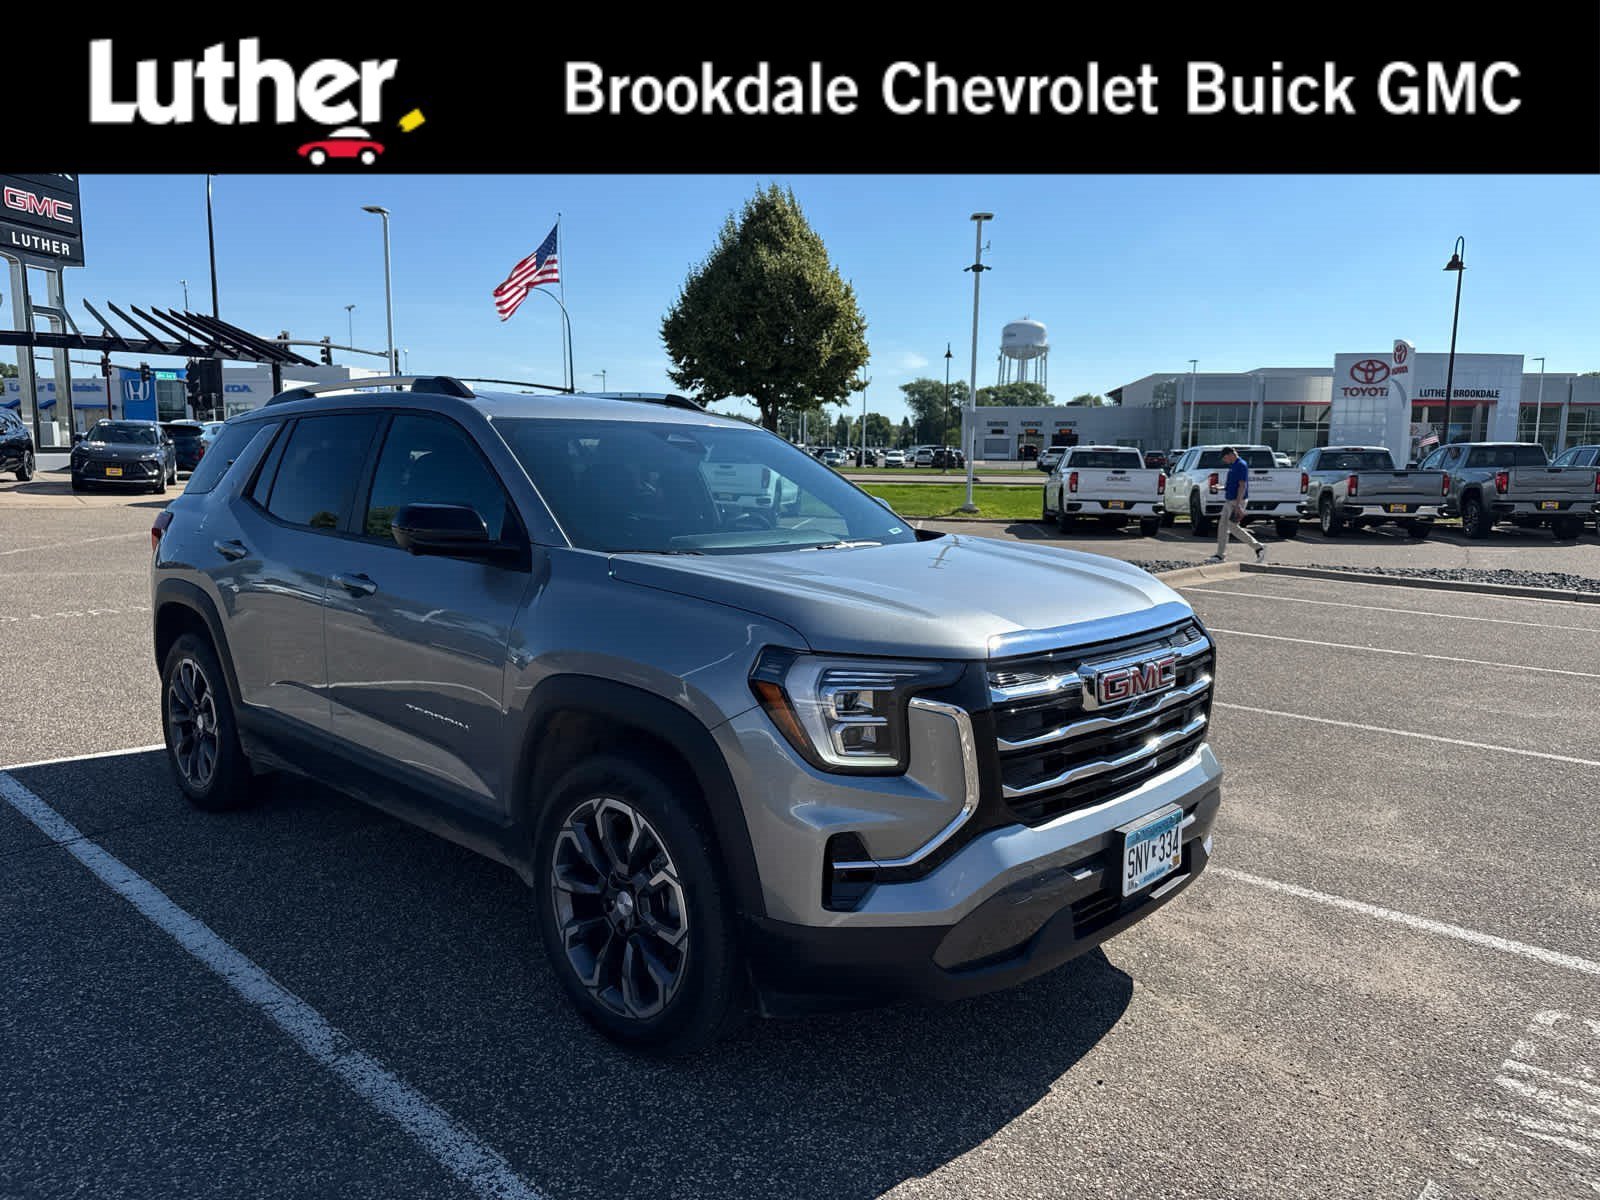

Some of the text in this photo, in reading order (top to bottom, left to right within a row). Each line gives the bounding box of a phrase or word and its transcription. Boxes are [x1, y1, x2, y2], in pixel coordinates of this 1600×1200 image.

[3, 185, 74, 225] GMC
[11, 231, 70, 256] LUTHER
[1419, 388, 1501, 399] LUTHE BROOKDALE
[1103, 657, 1176, 701] GMC
[1127, 839, 1151, 880] SNV
[1158, 825, 1179, 862] 334
